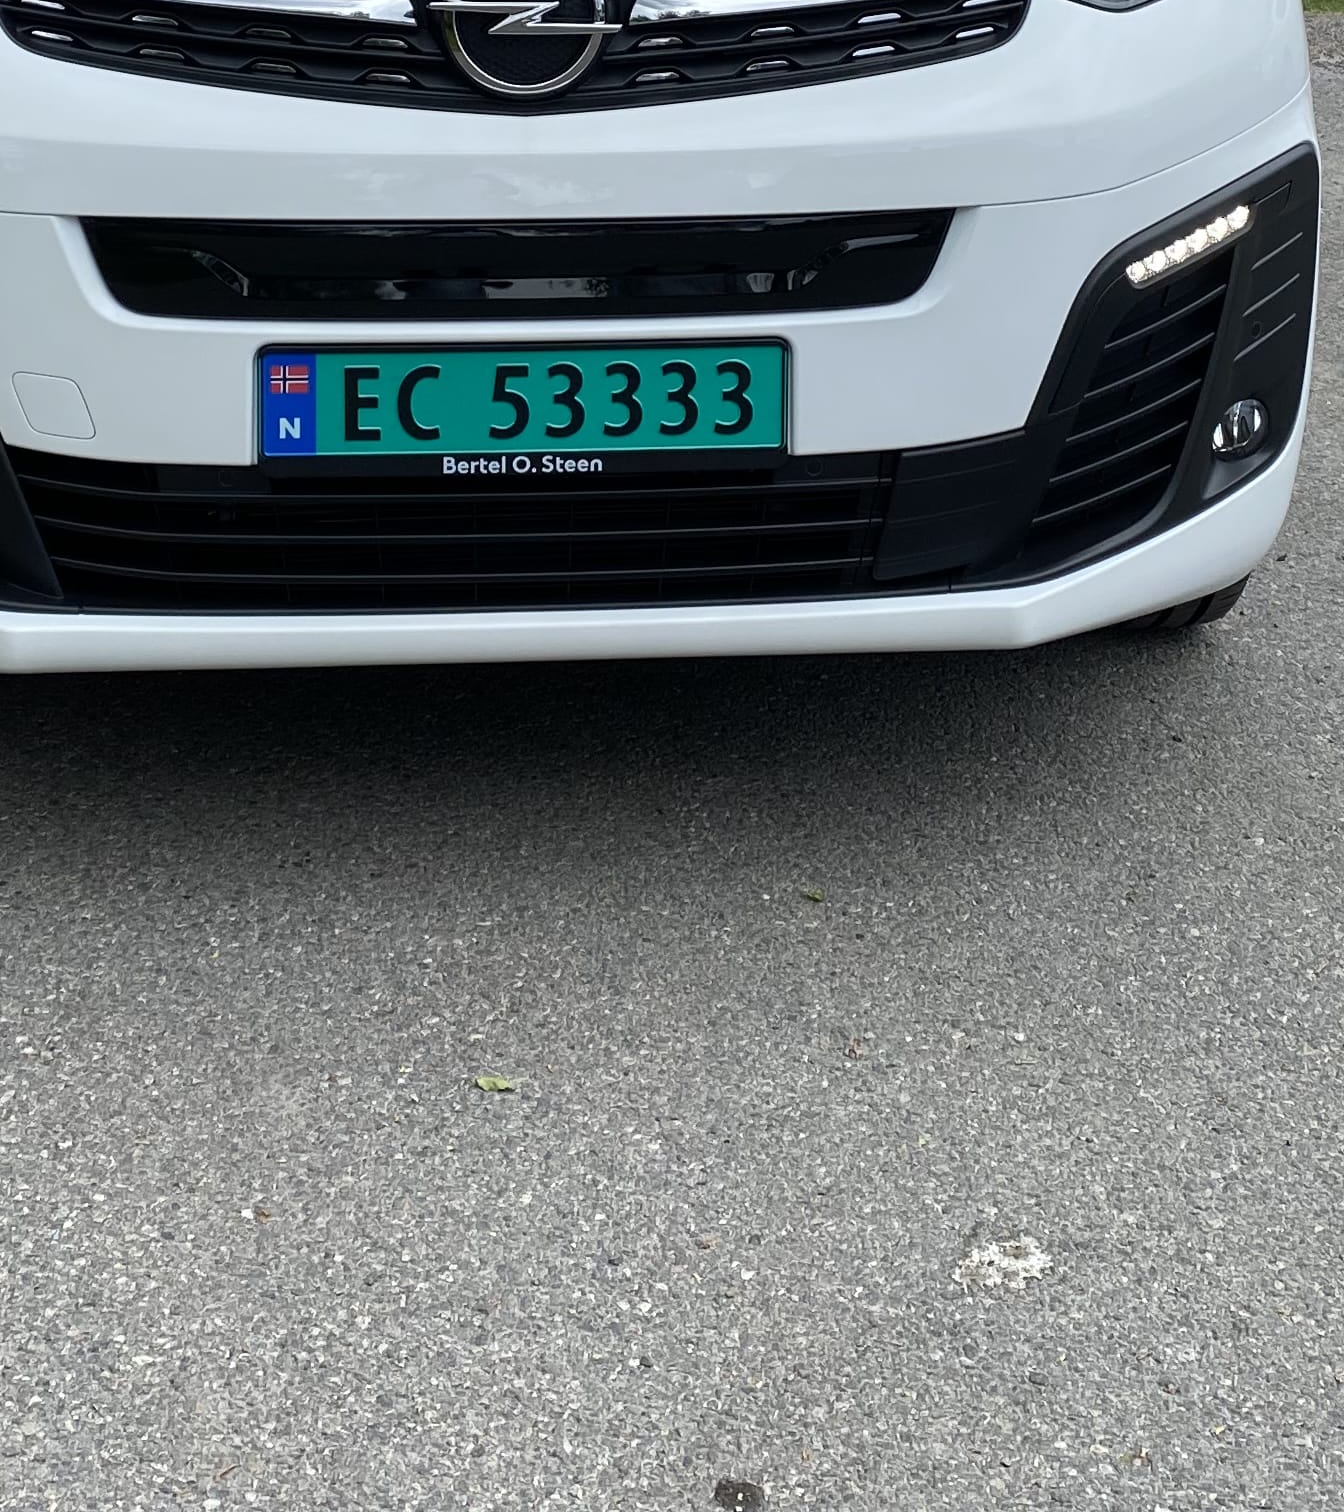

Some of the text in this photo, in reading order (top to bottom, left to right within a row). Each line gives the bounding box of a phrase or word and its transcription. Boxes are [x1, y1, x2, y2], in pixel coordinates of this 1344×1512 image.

[344, 358, 754, 441] EC 53333
[279, 417, 301, 440] N
[442, 455, 603, 475] Bertel O. Steen
